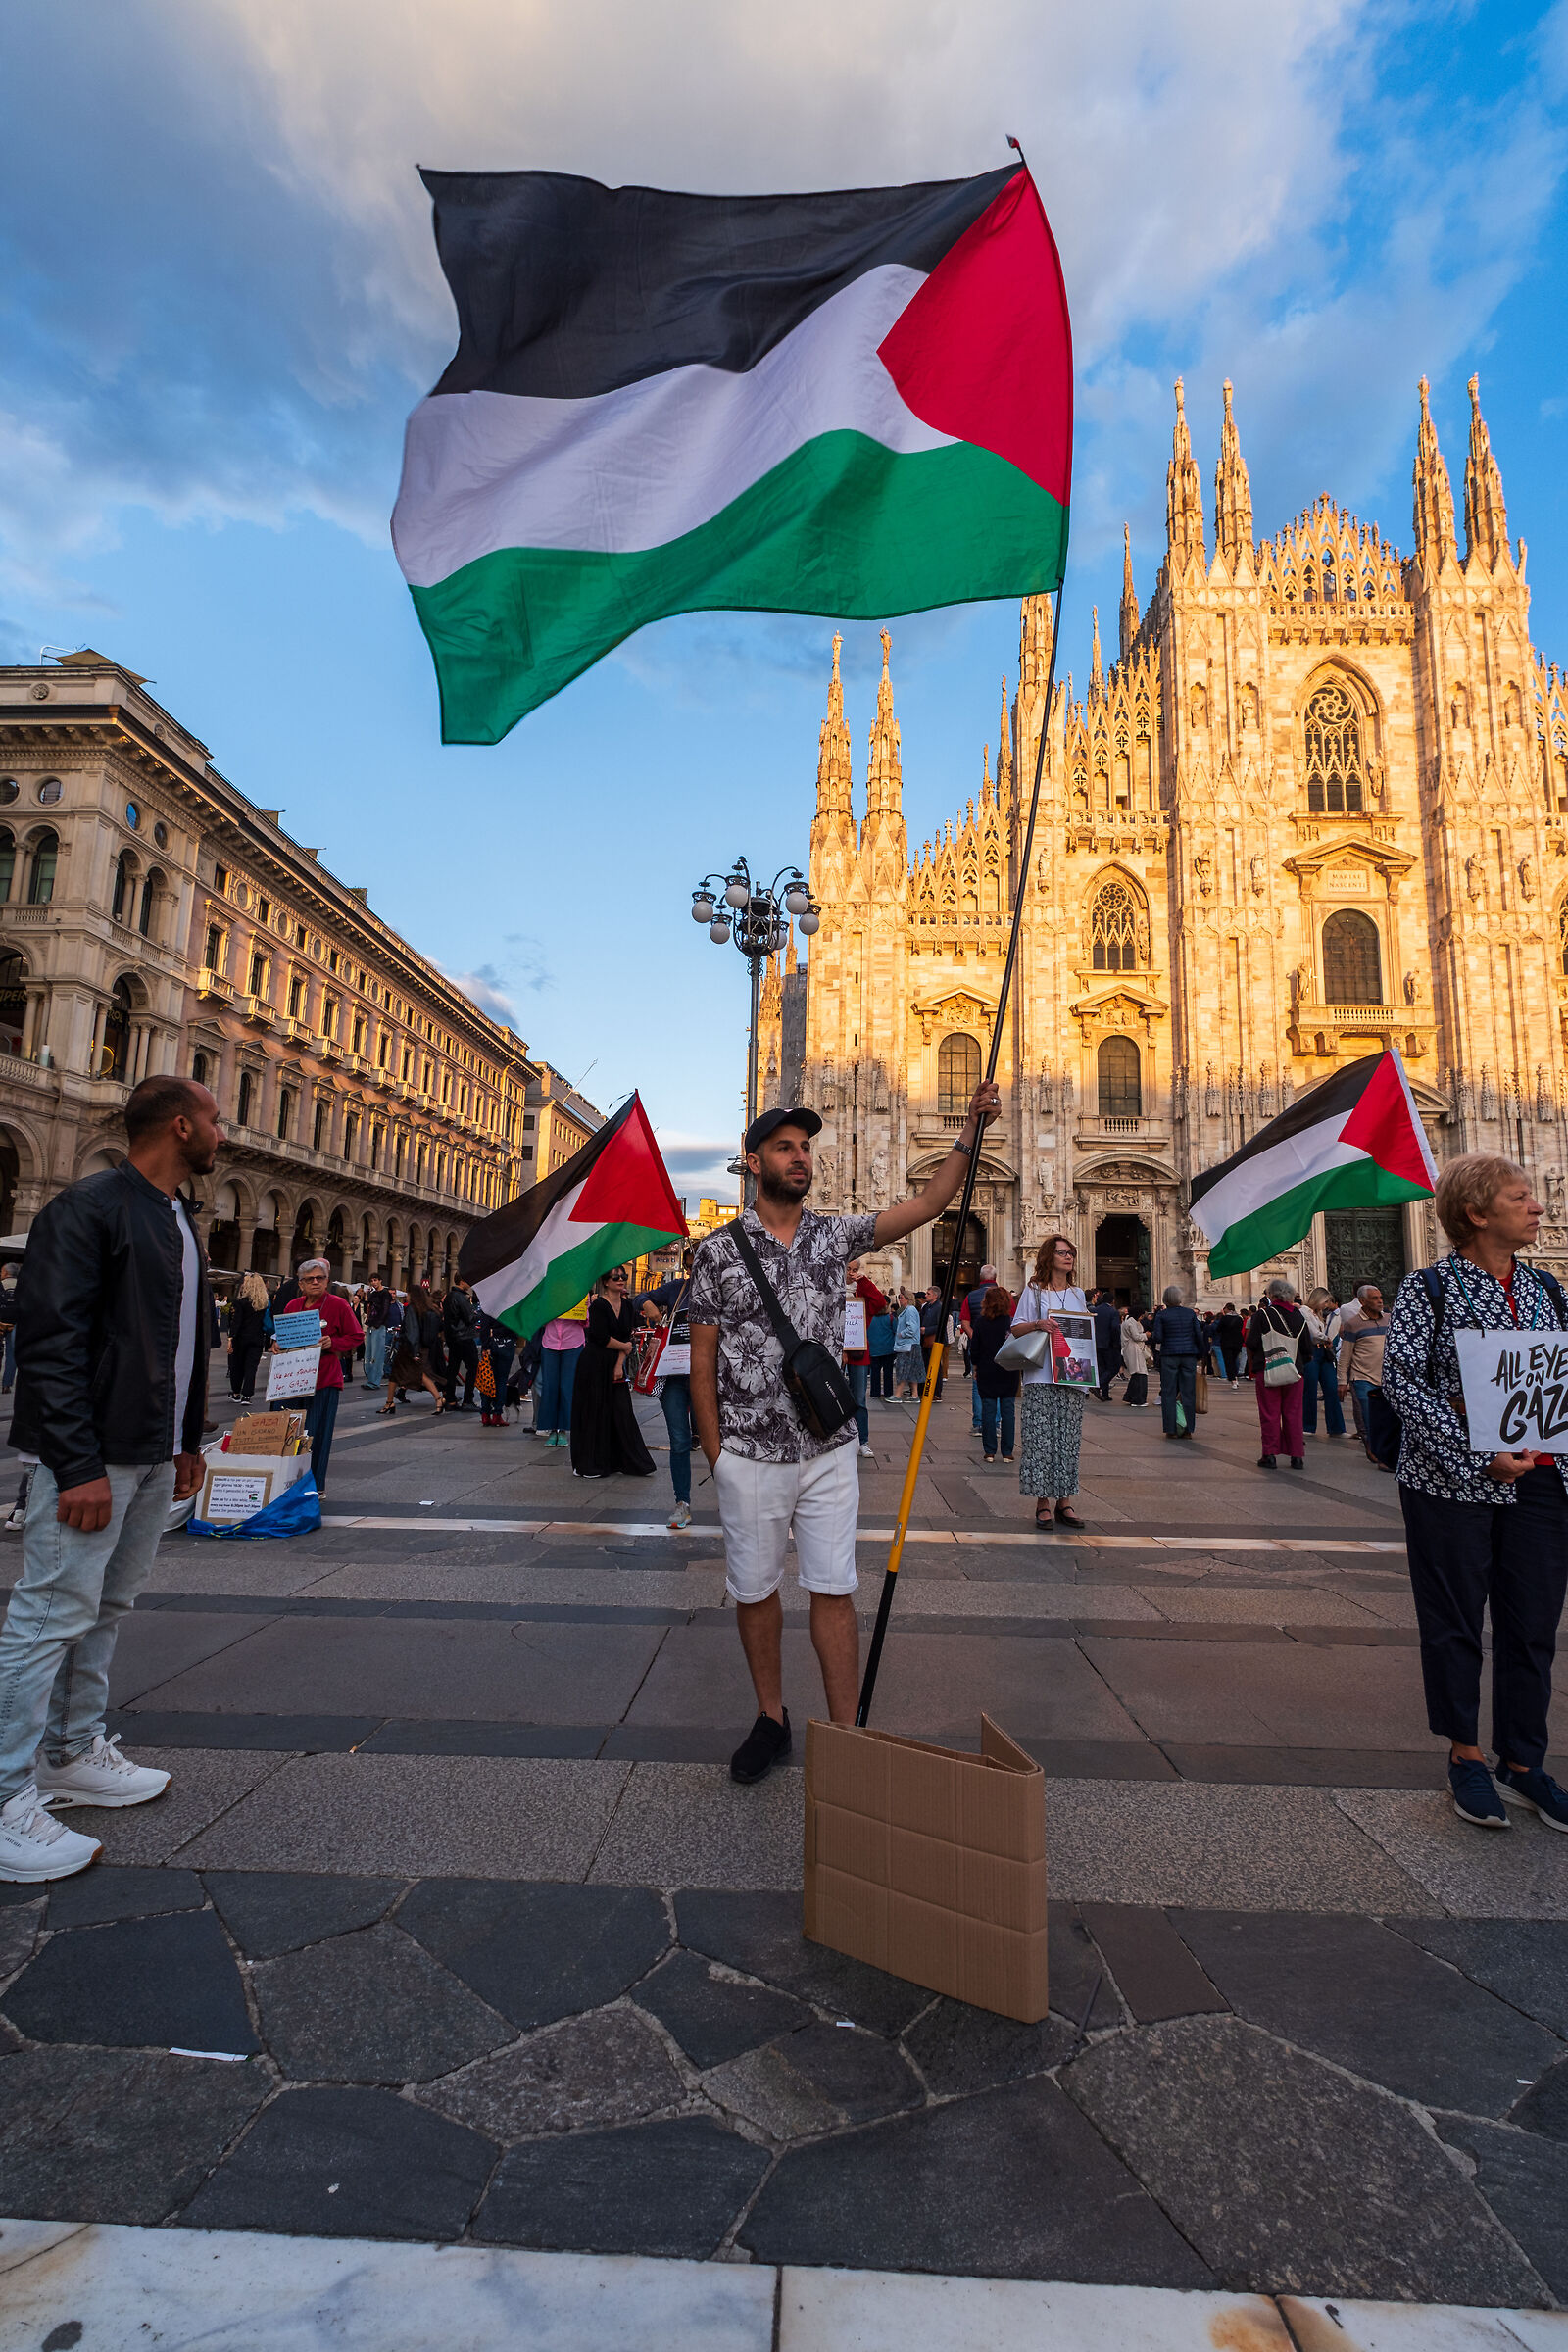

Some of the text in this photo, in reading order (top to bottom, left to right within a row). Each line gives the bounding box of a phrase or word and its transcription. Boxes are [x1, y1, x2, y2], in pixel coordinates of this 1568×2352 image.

[1491, 1349, 1526, 1394] ALL
[289, 1379, 309, 1388] GAZA
[1526, 1370, 1544, 1388] ON
[252, 1418, 279, 1427] GAZA
